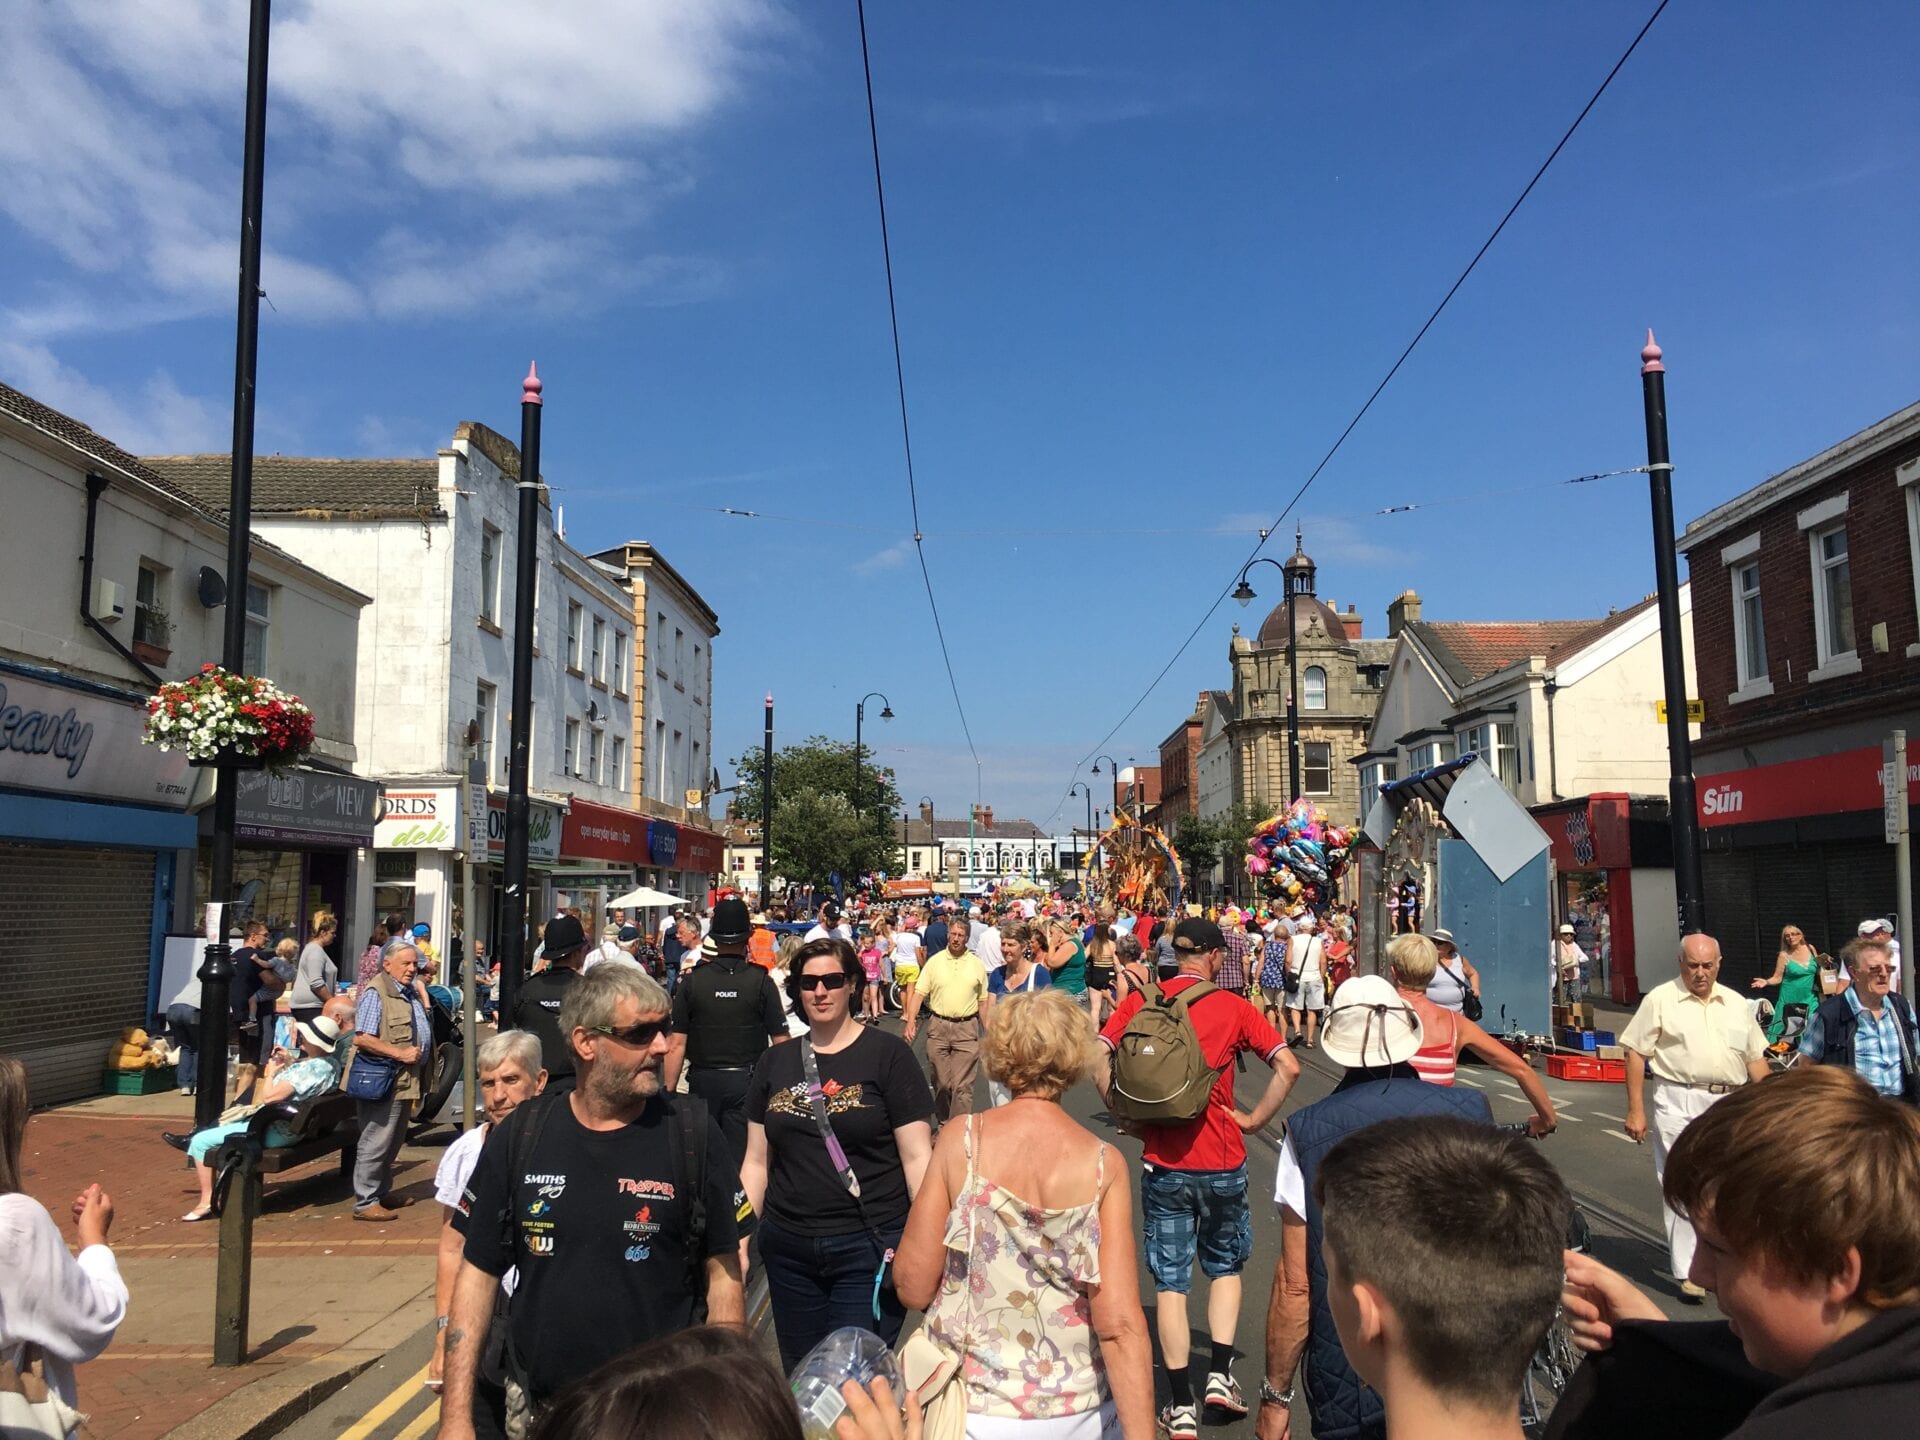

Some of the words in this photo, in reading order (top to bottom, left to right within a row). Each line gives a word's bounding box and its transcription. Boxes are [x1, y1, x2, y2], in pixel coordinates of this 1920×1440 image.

[0, 683, 94, 779] eauty
[165, 783, 187, 796] 877444
[336, 785, 365, 817] NEW
[1703, 788, 1743, 815] Sun
[384, 798, 436, 814] ORDS
[391, 821, 451, 847] deli
[664, 832, 677, 860] stop
[524, 1174, 567, 1185] SMITHS
[618, 1178, 676, 1200] TROOPER
[624, 1244, 651, 1262] 666
